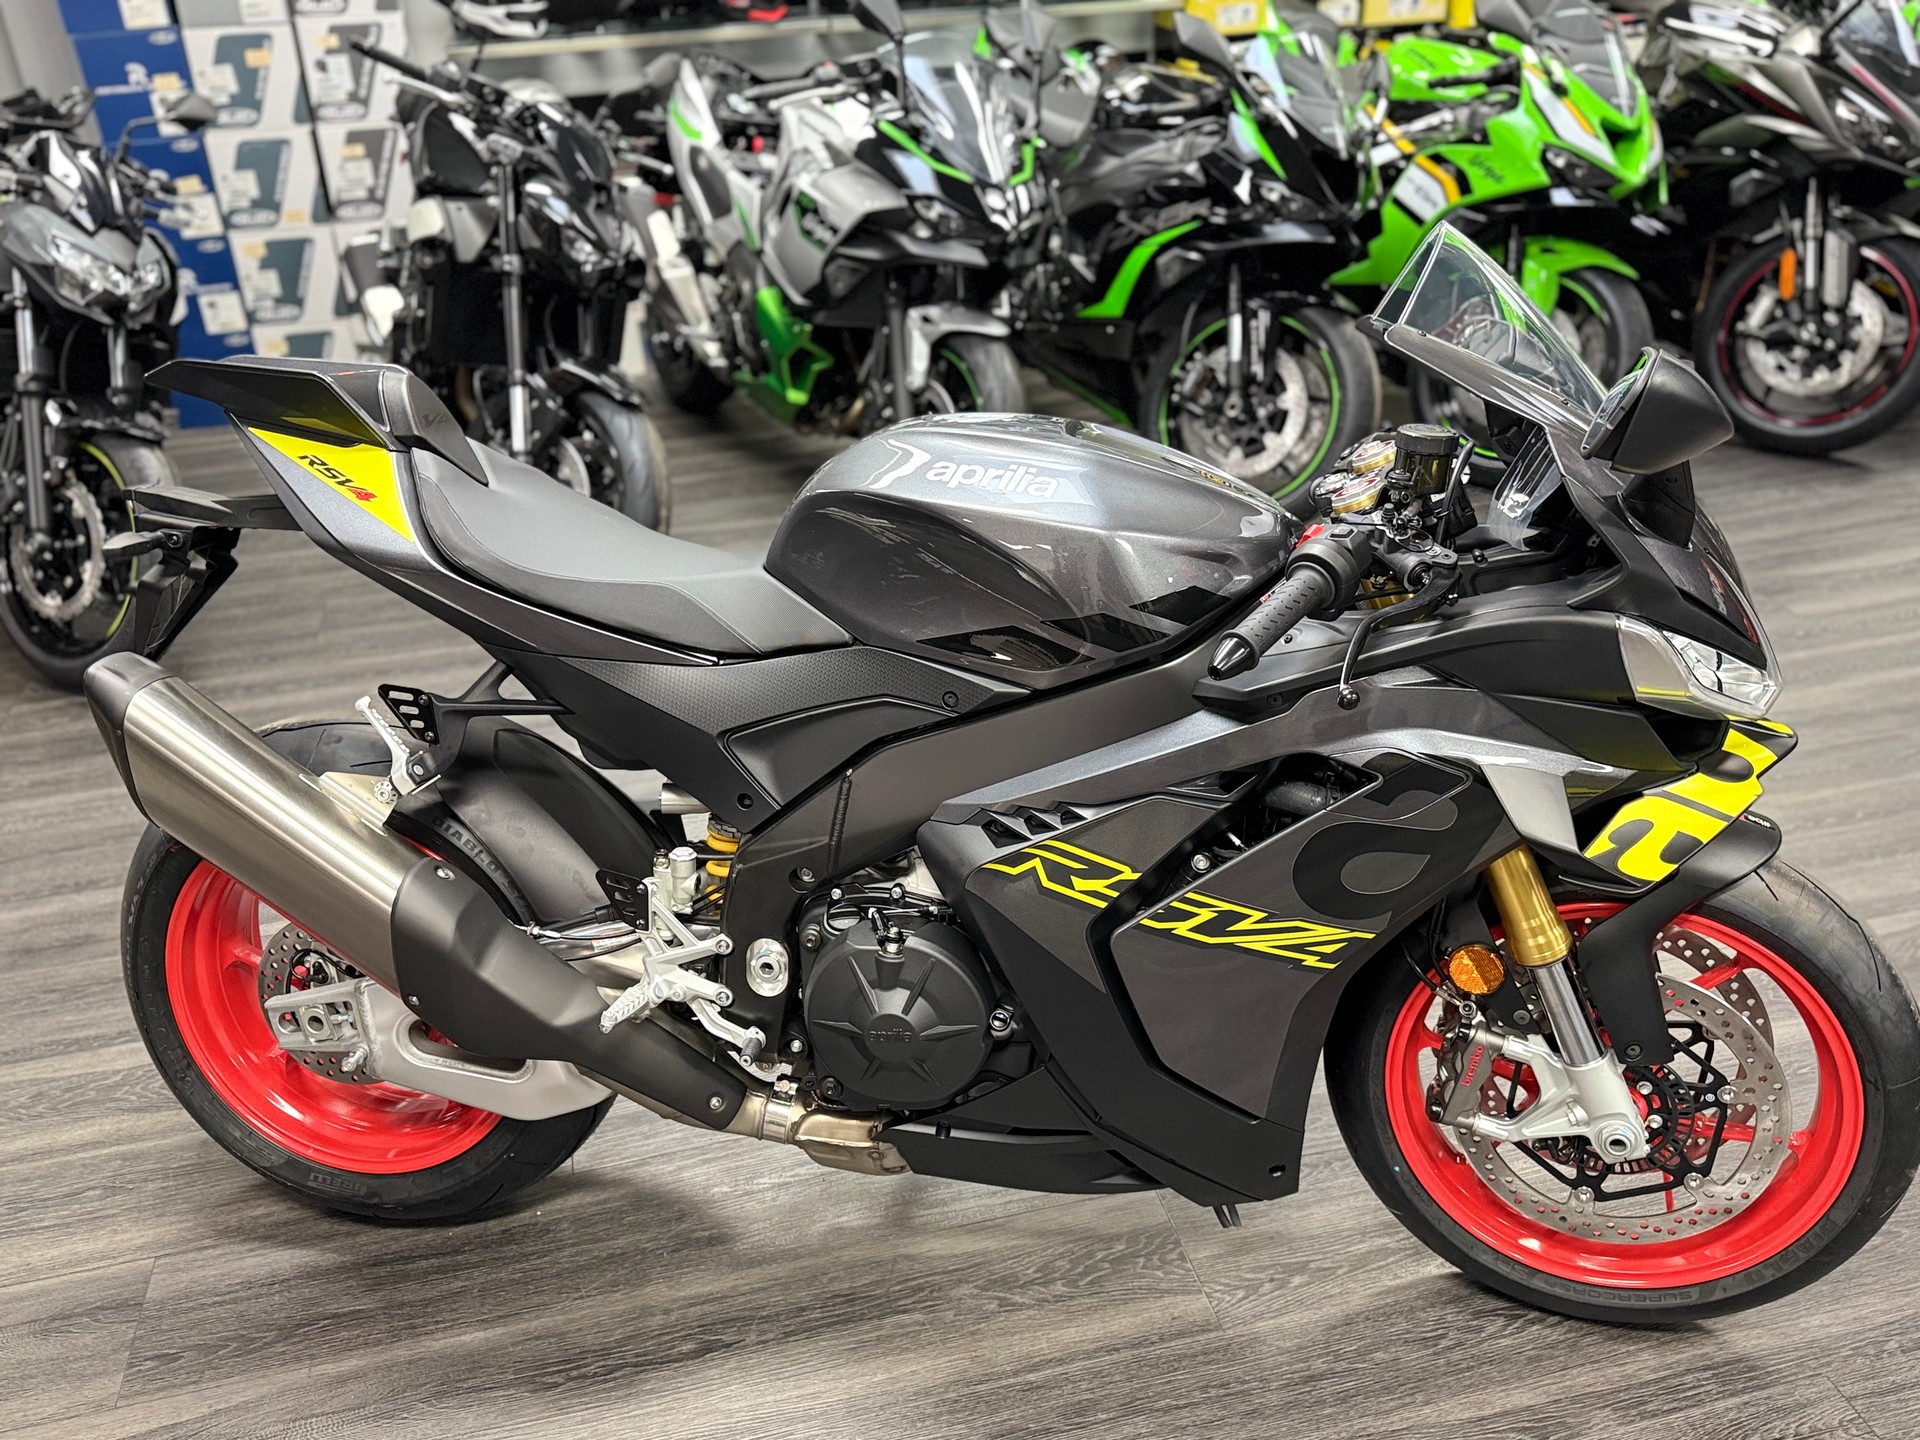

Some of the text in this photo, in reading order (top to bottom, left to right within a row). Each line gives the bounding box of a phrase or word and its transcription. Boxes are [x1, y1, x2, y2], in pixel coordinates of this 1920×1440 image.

[297, 454, 378, 503] RSV4
[925, 460, 1060, 499] aprilia
[869, 1028, 912, 1042] aprilia
[1461, 1044, 1485, 1087] brembo
[1544, 1272, 1694, 1303] SUPERCORSA
